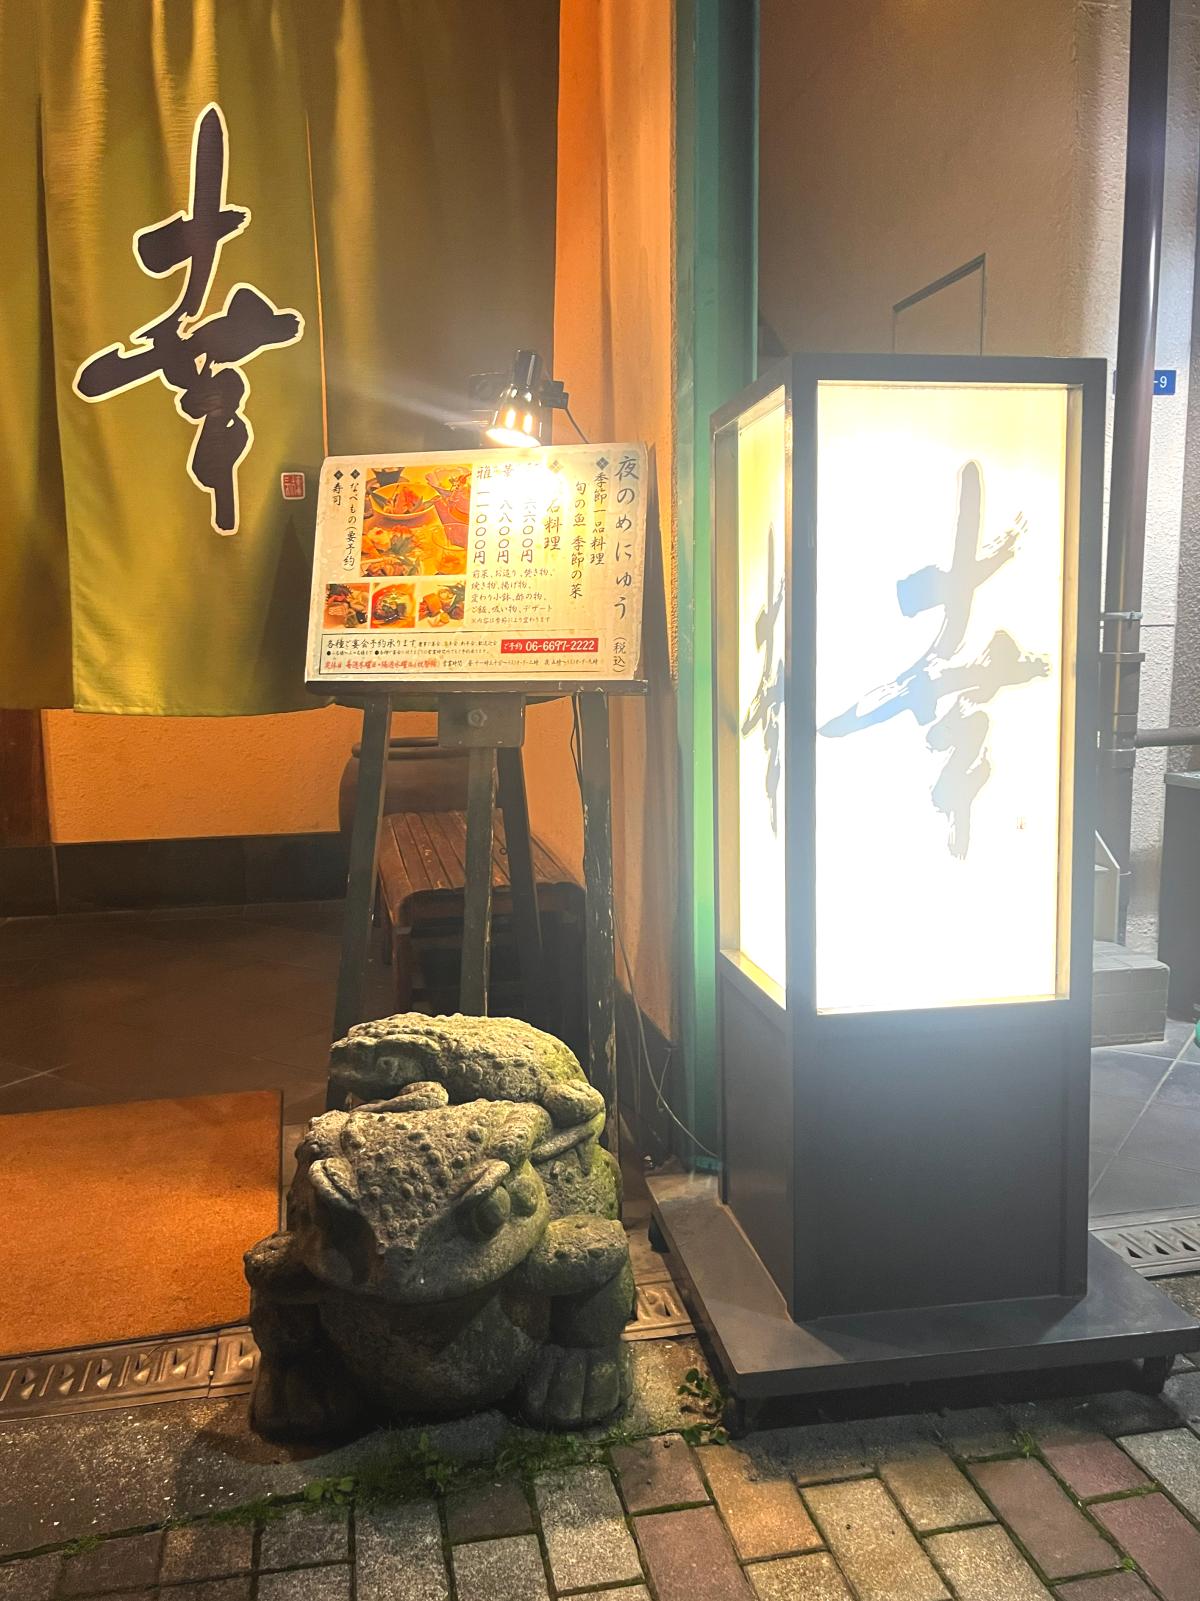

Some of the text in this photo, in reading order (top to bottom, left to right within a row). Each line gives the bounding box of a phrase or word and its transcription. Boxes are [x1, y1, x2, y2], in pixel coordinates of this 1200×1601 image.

[332, 482, 344, 506] 寿司
[543, 482, 564, 552] 石料理
[572, 480, 588, 527] 旬の魚
[590, 472, 610, 566] 季節一品料理
[614, 456, 640, 620] 夜のめにゅう
[525, 639, 595, 652] 06-6697-2222
